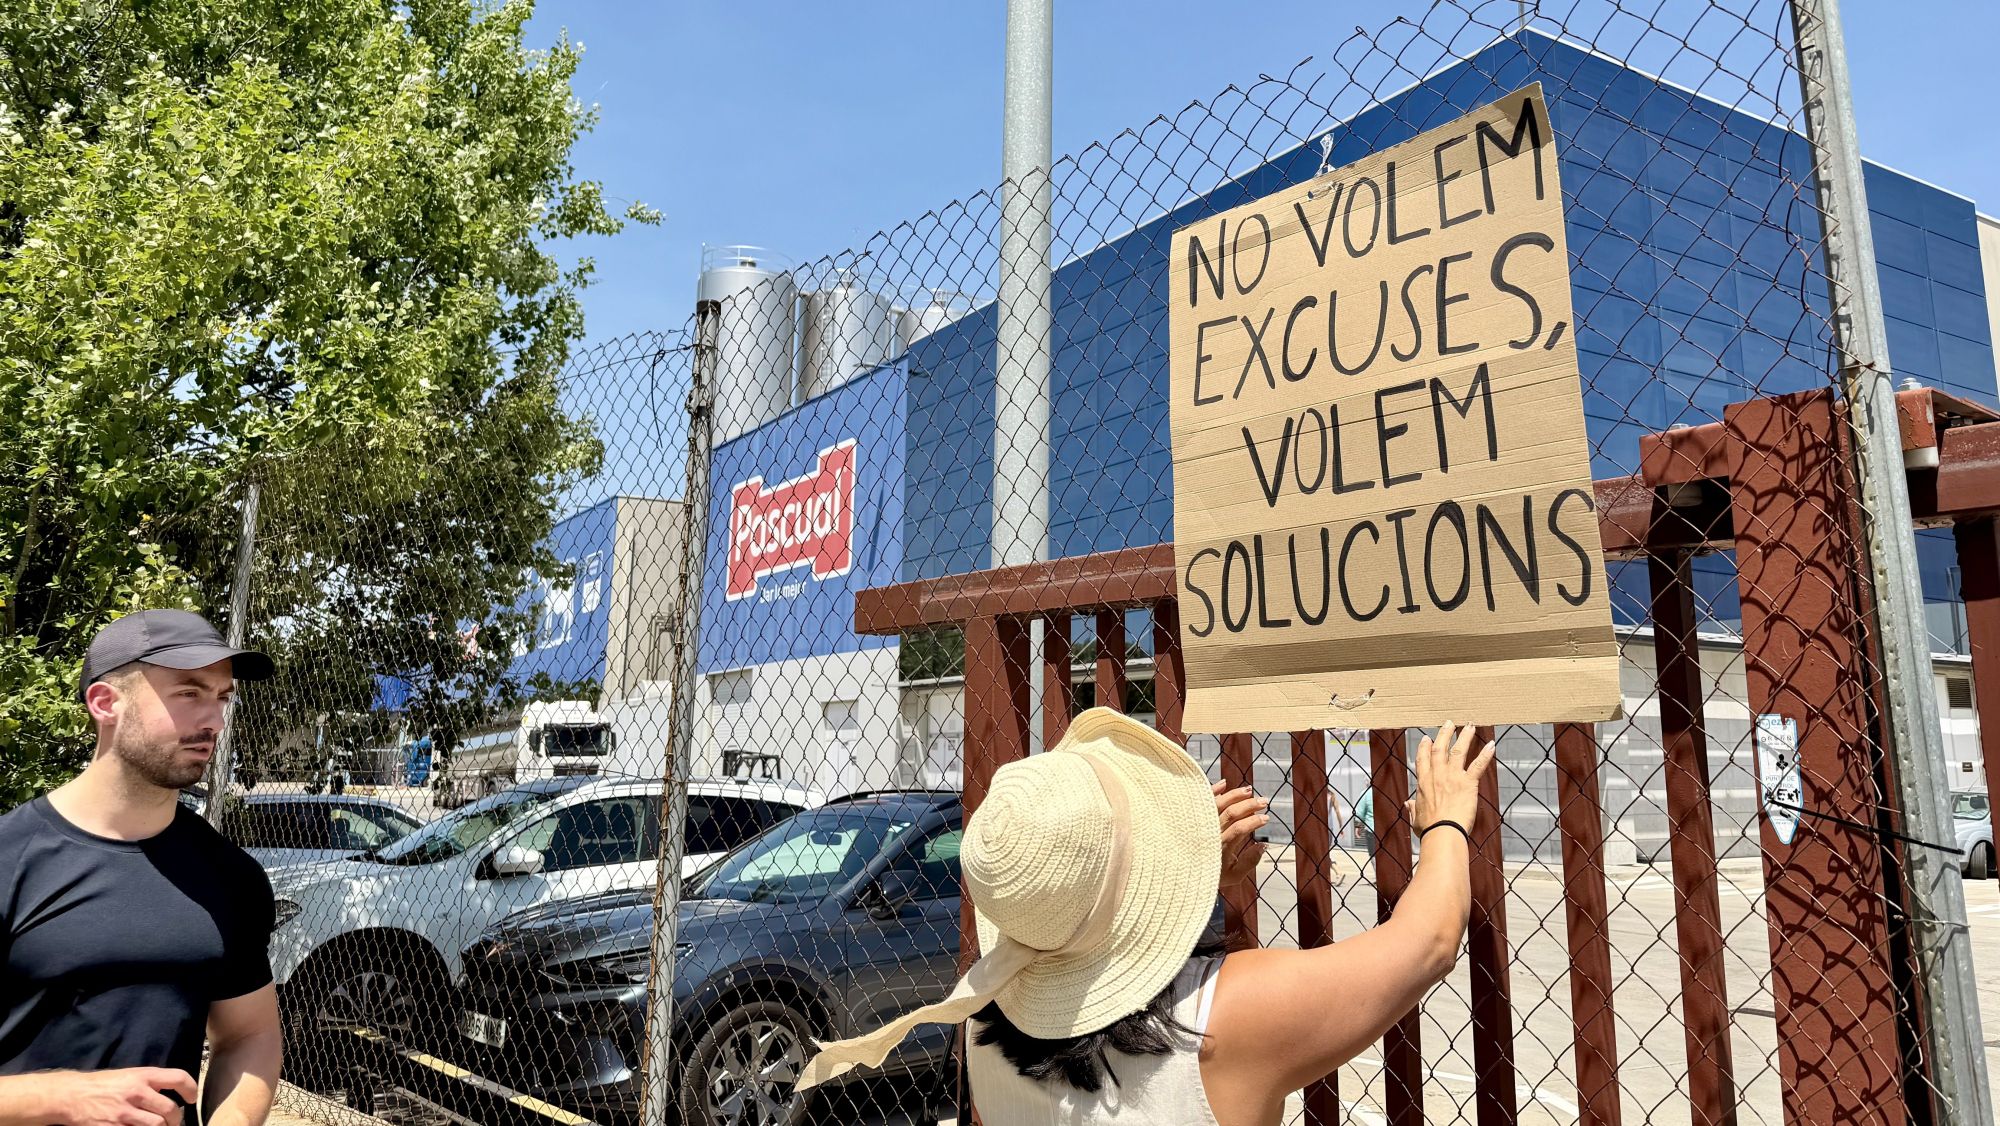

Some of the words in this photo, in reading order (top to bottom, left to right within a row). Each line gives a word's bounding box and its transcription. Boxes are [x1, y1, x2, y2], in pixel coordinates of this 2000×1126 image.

[1189, 213, 1271, 308] NO
[1294, 97, 1545, 268] VOLEM
[1194, 231, 1567, 407] EXCUSES,
[1241, 361, 1498, 508] VOLEM
[734, 467, 848, 562] Pascual
[1184, 488, 1595, 638] SOLUCIONS
